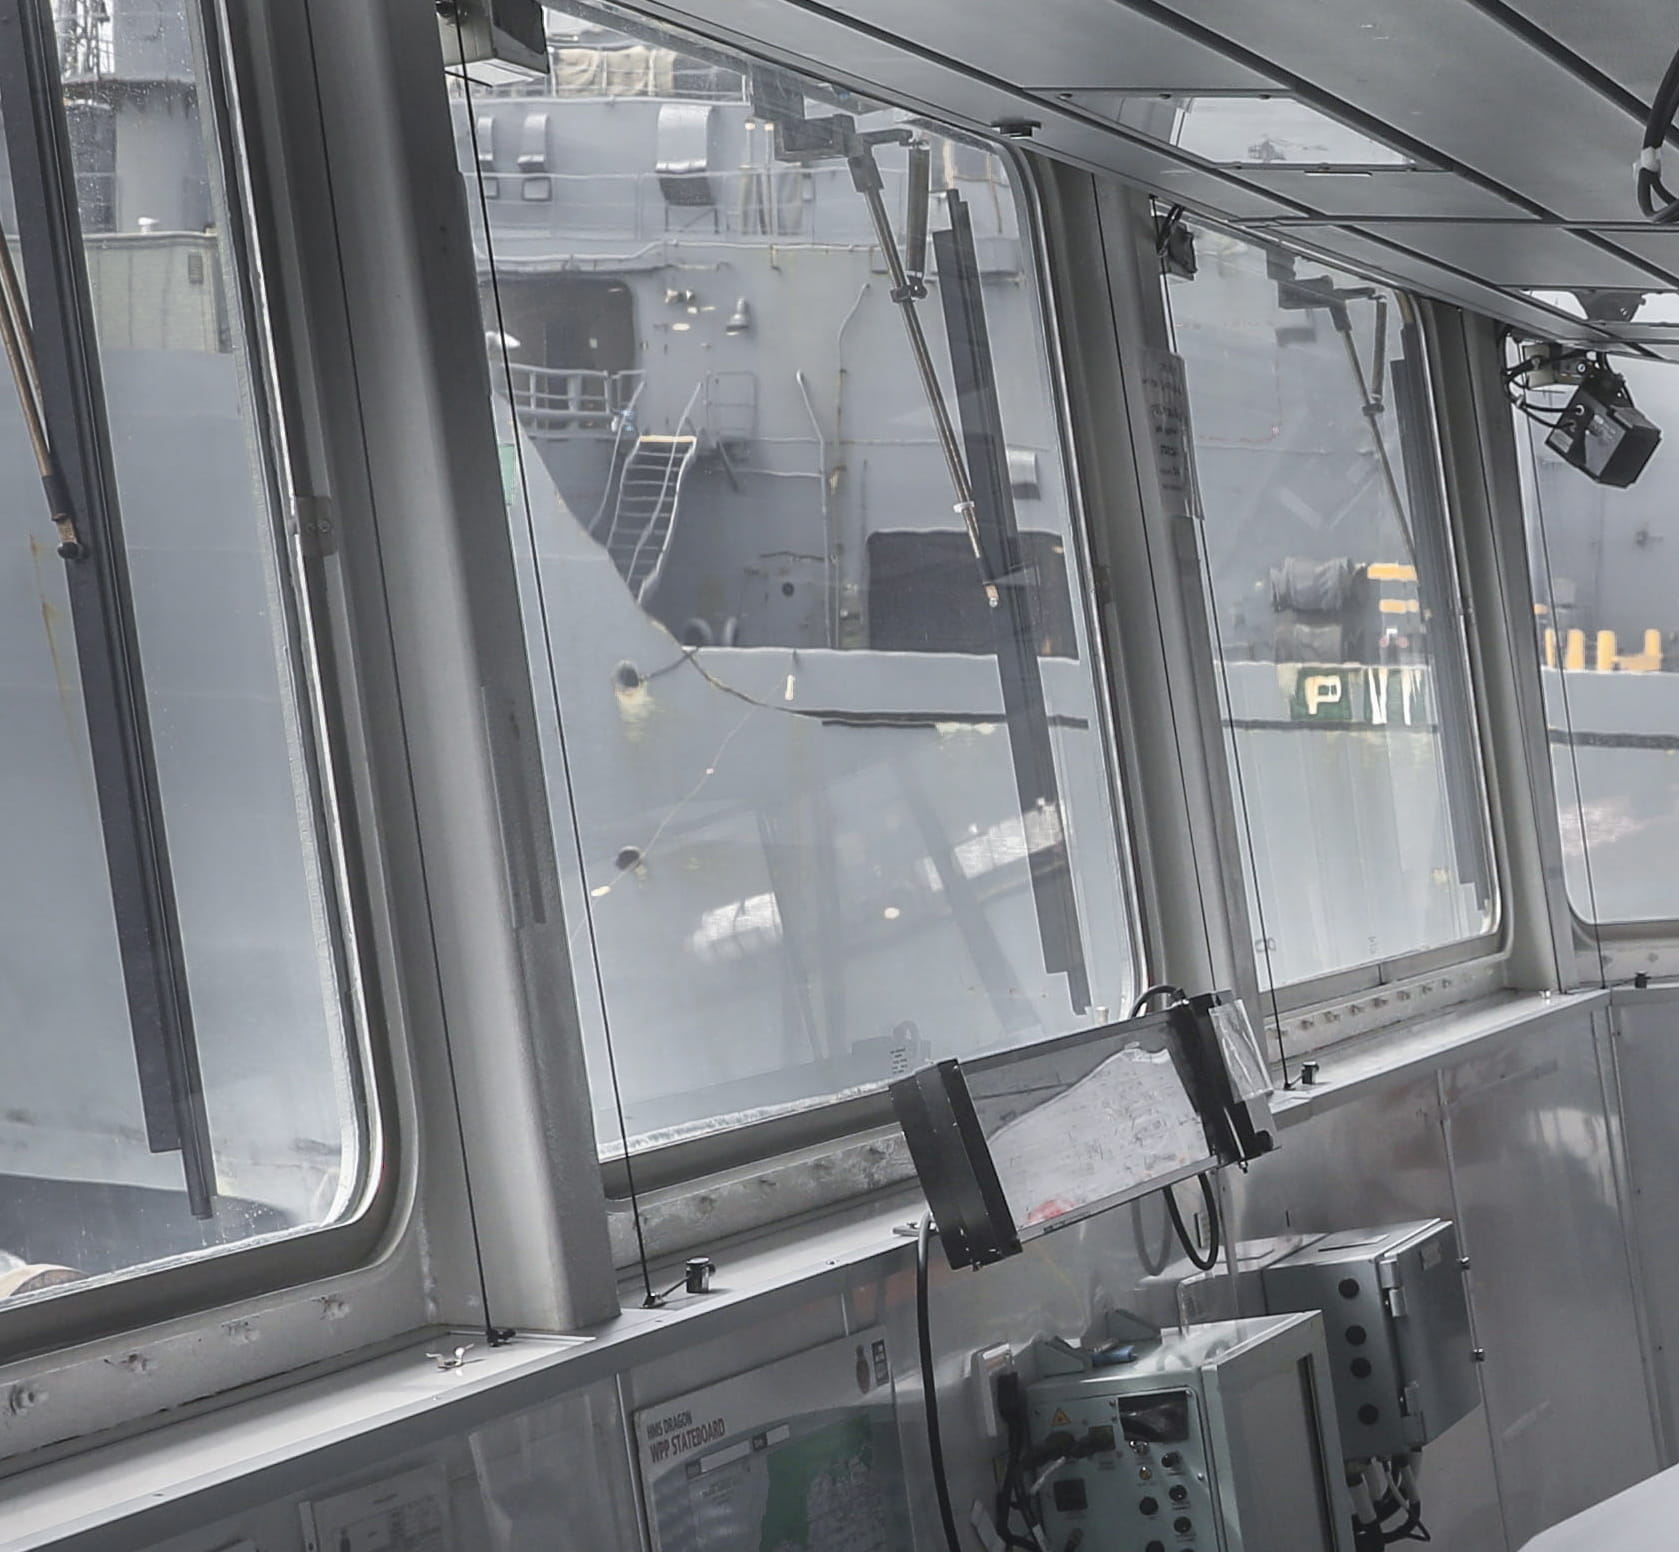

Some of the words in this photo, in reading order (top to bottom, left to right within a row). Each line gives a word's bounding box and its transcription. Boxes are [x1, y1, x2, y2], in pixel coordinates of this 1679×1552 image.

[663, 1410, 693, 1432] DRAGON
[649, 1439, 671, 1464] WPP
[671, 1418, 726, 1455] STATEBOARD
